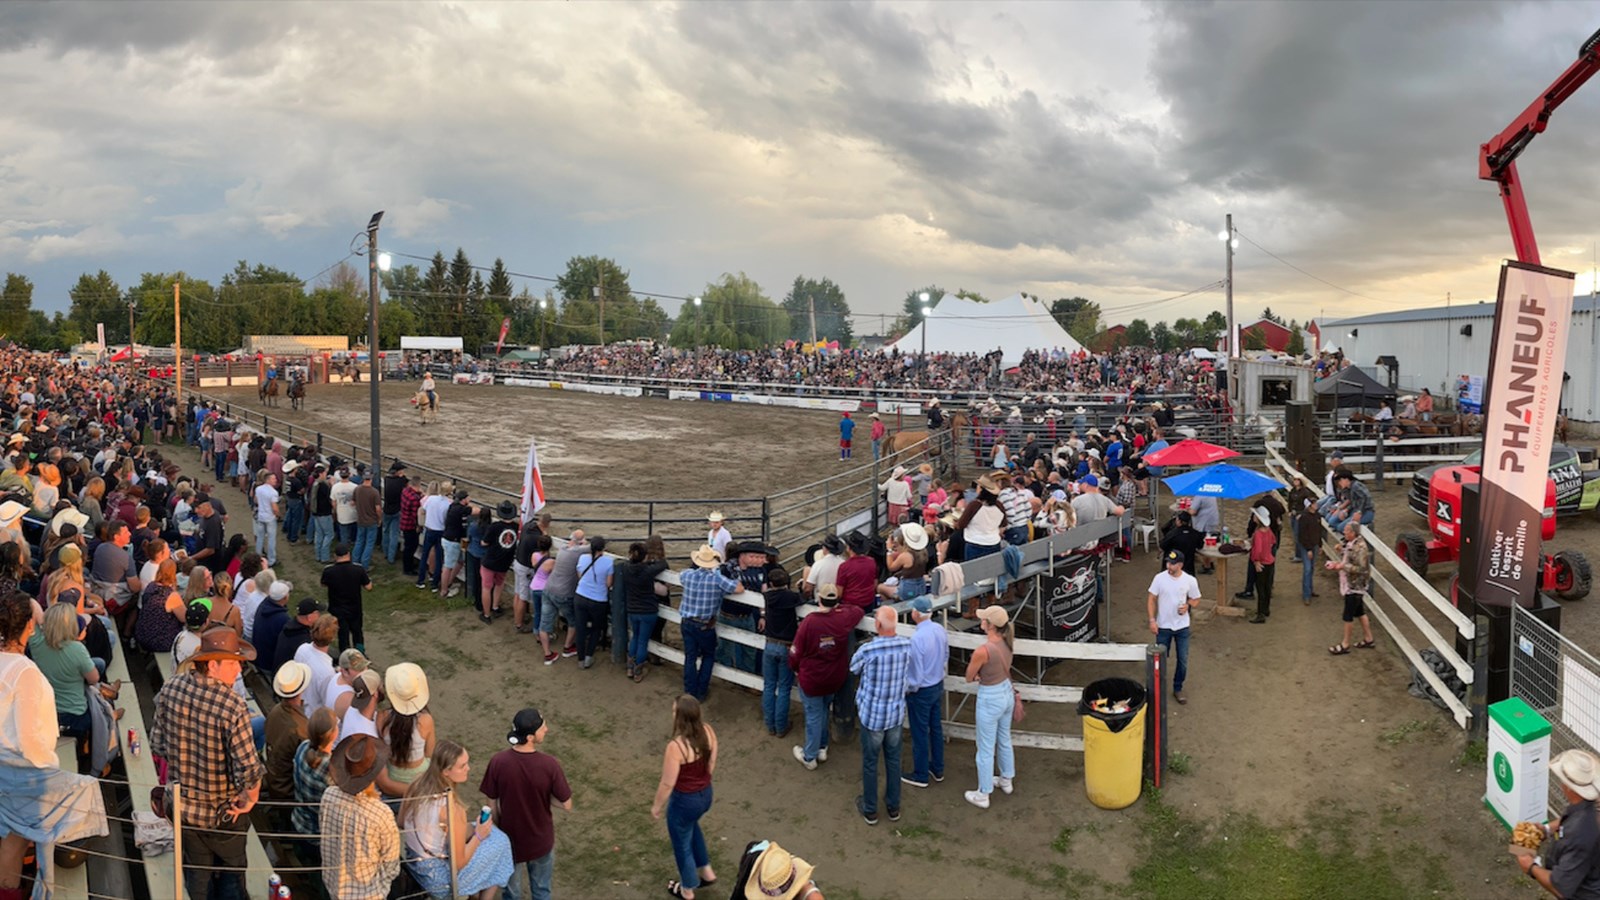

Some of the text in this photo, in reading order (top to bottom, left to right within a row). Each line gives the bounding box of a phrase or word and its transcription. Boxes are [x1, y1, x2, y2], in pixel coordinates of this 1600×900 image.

[1499, 294, 1546, 474] PHANEUF
[1533, 320, 1558, 458] ÉQUIPEMENTS AGRICOLES
[1489, 530, 1504, 577] Cultiver
[1500, 536, 1515, 578] l'esprit
[1512, 519, 1528, 580] de famille
